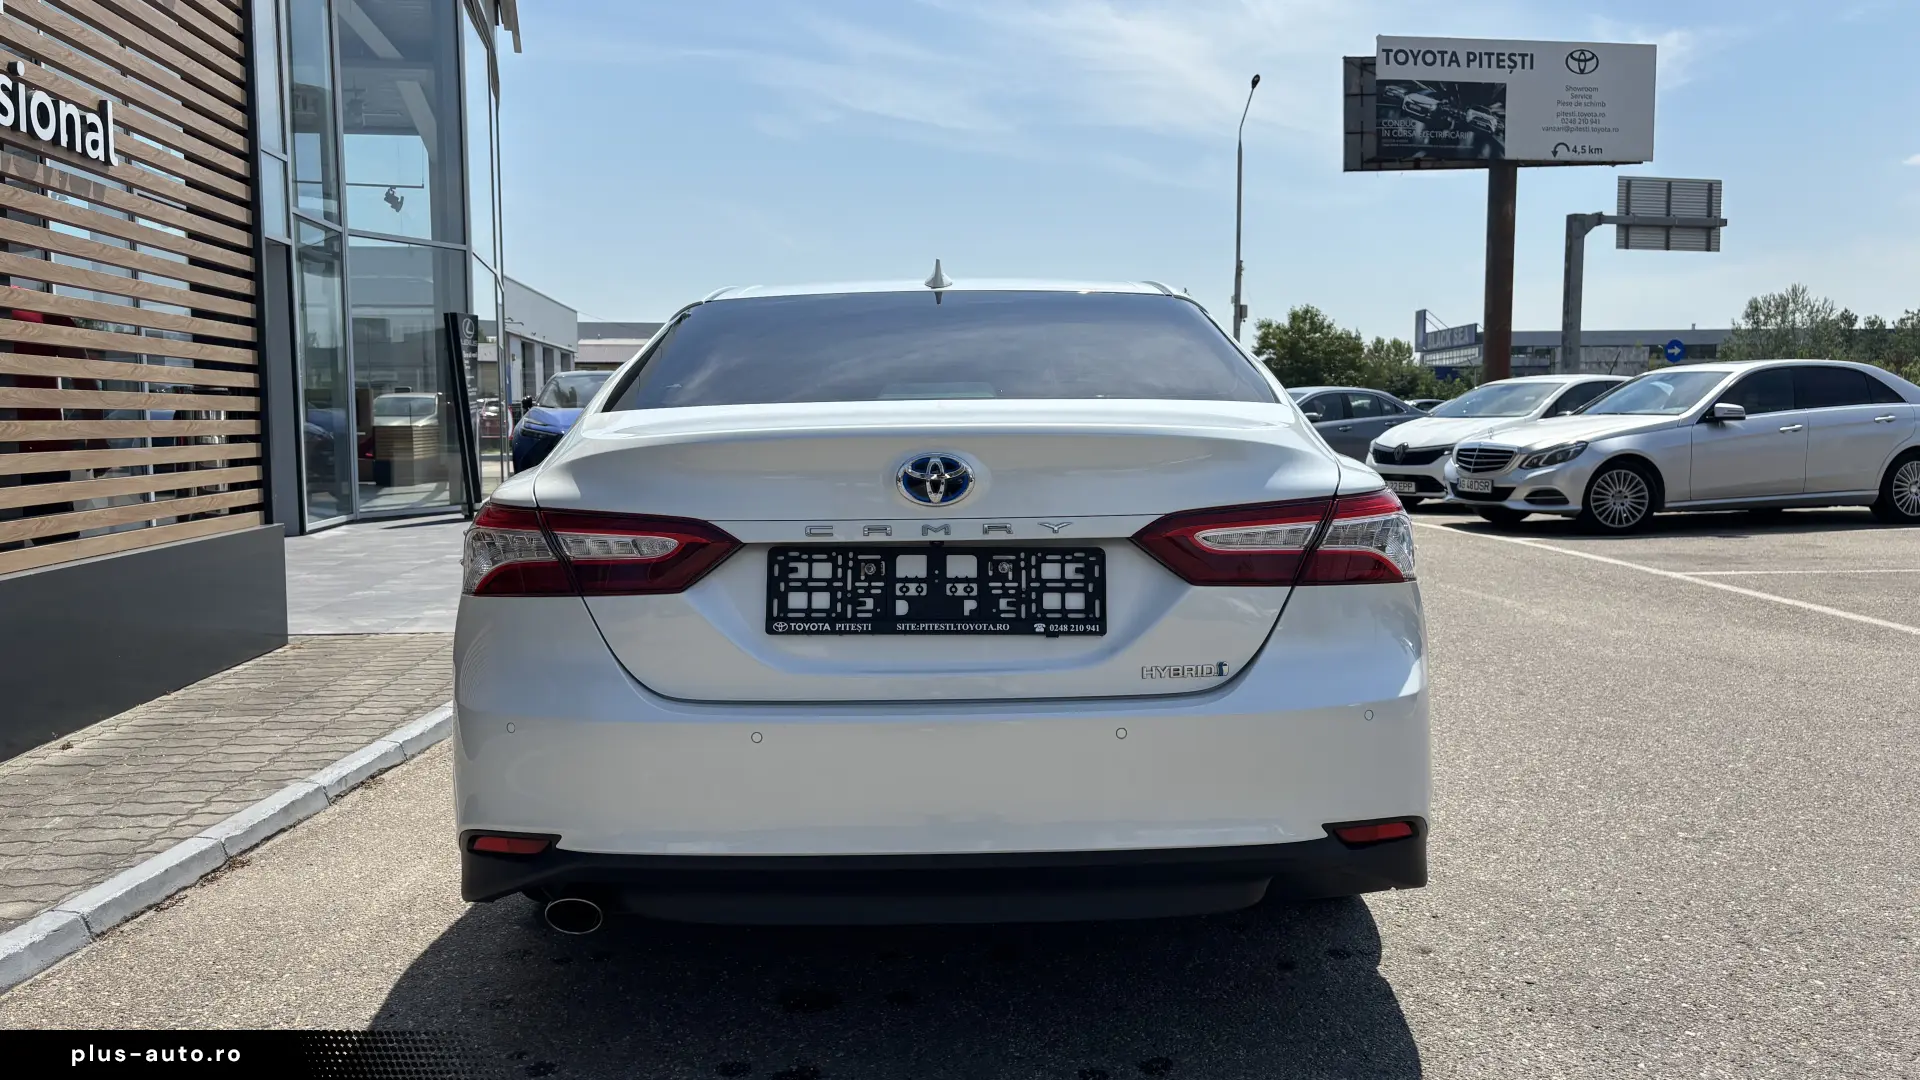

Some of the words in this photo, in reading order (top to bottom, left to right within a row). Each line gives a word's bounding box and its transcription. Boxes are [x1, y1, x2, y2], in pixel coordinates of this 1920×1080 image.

[1381, 48, 1461, 67] TOYOTA
[1466, 51, 1534, 74] PITEȘTI
[1571, 145, 1587, 155] 4,5
[1588, 145, 1603, 154] km
[1427, 329, 1452, 350] BLACK
[804, 521, 1073, 537] CAMRY
[789, 622, 831, 631] TOYOTA
[1049, 623, 1068, 632] 0248
[1070, 623, 1085, 632] 210
[1085, 623, 1100, 632] 941
[1141, 664, 1216, 679] HYBRID
